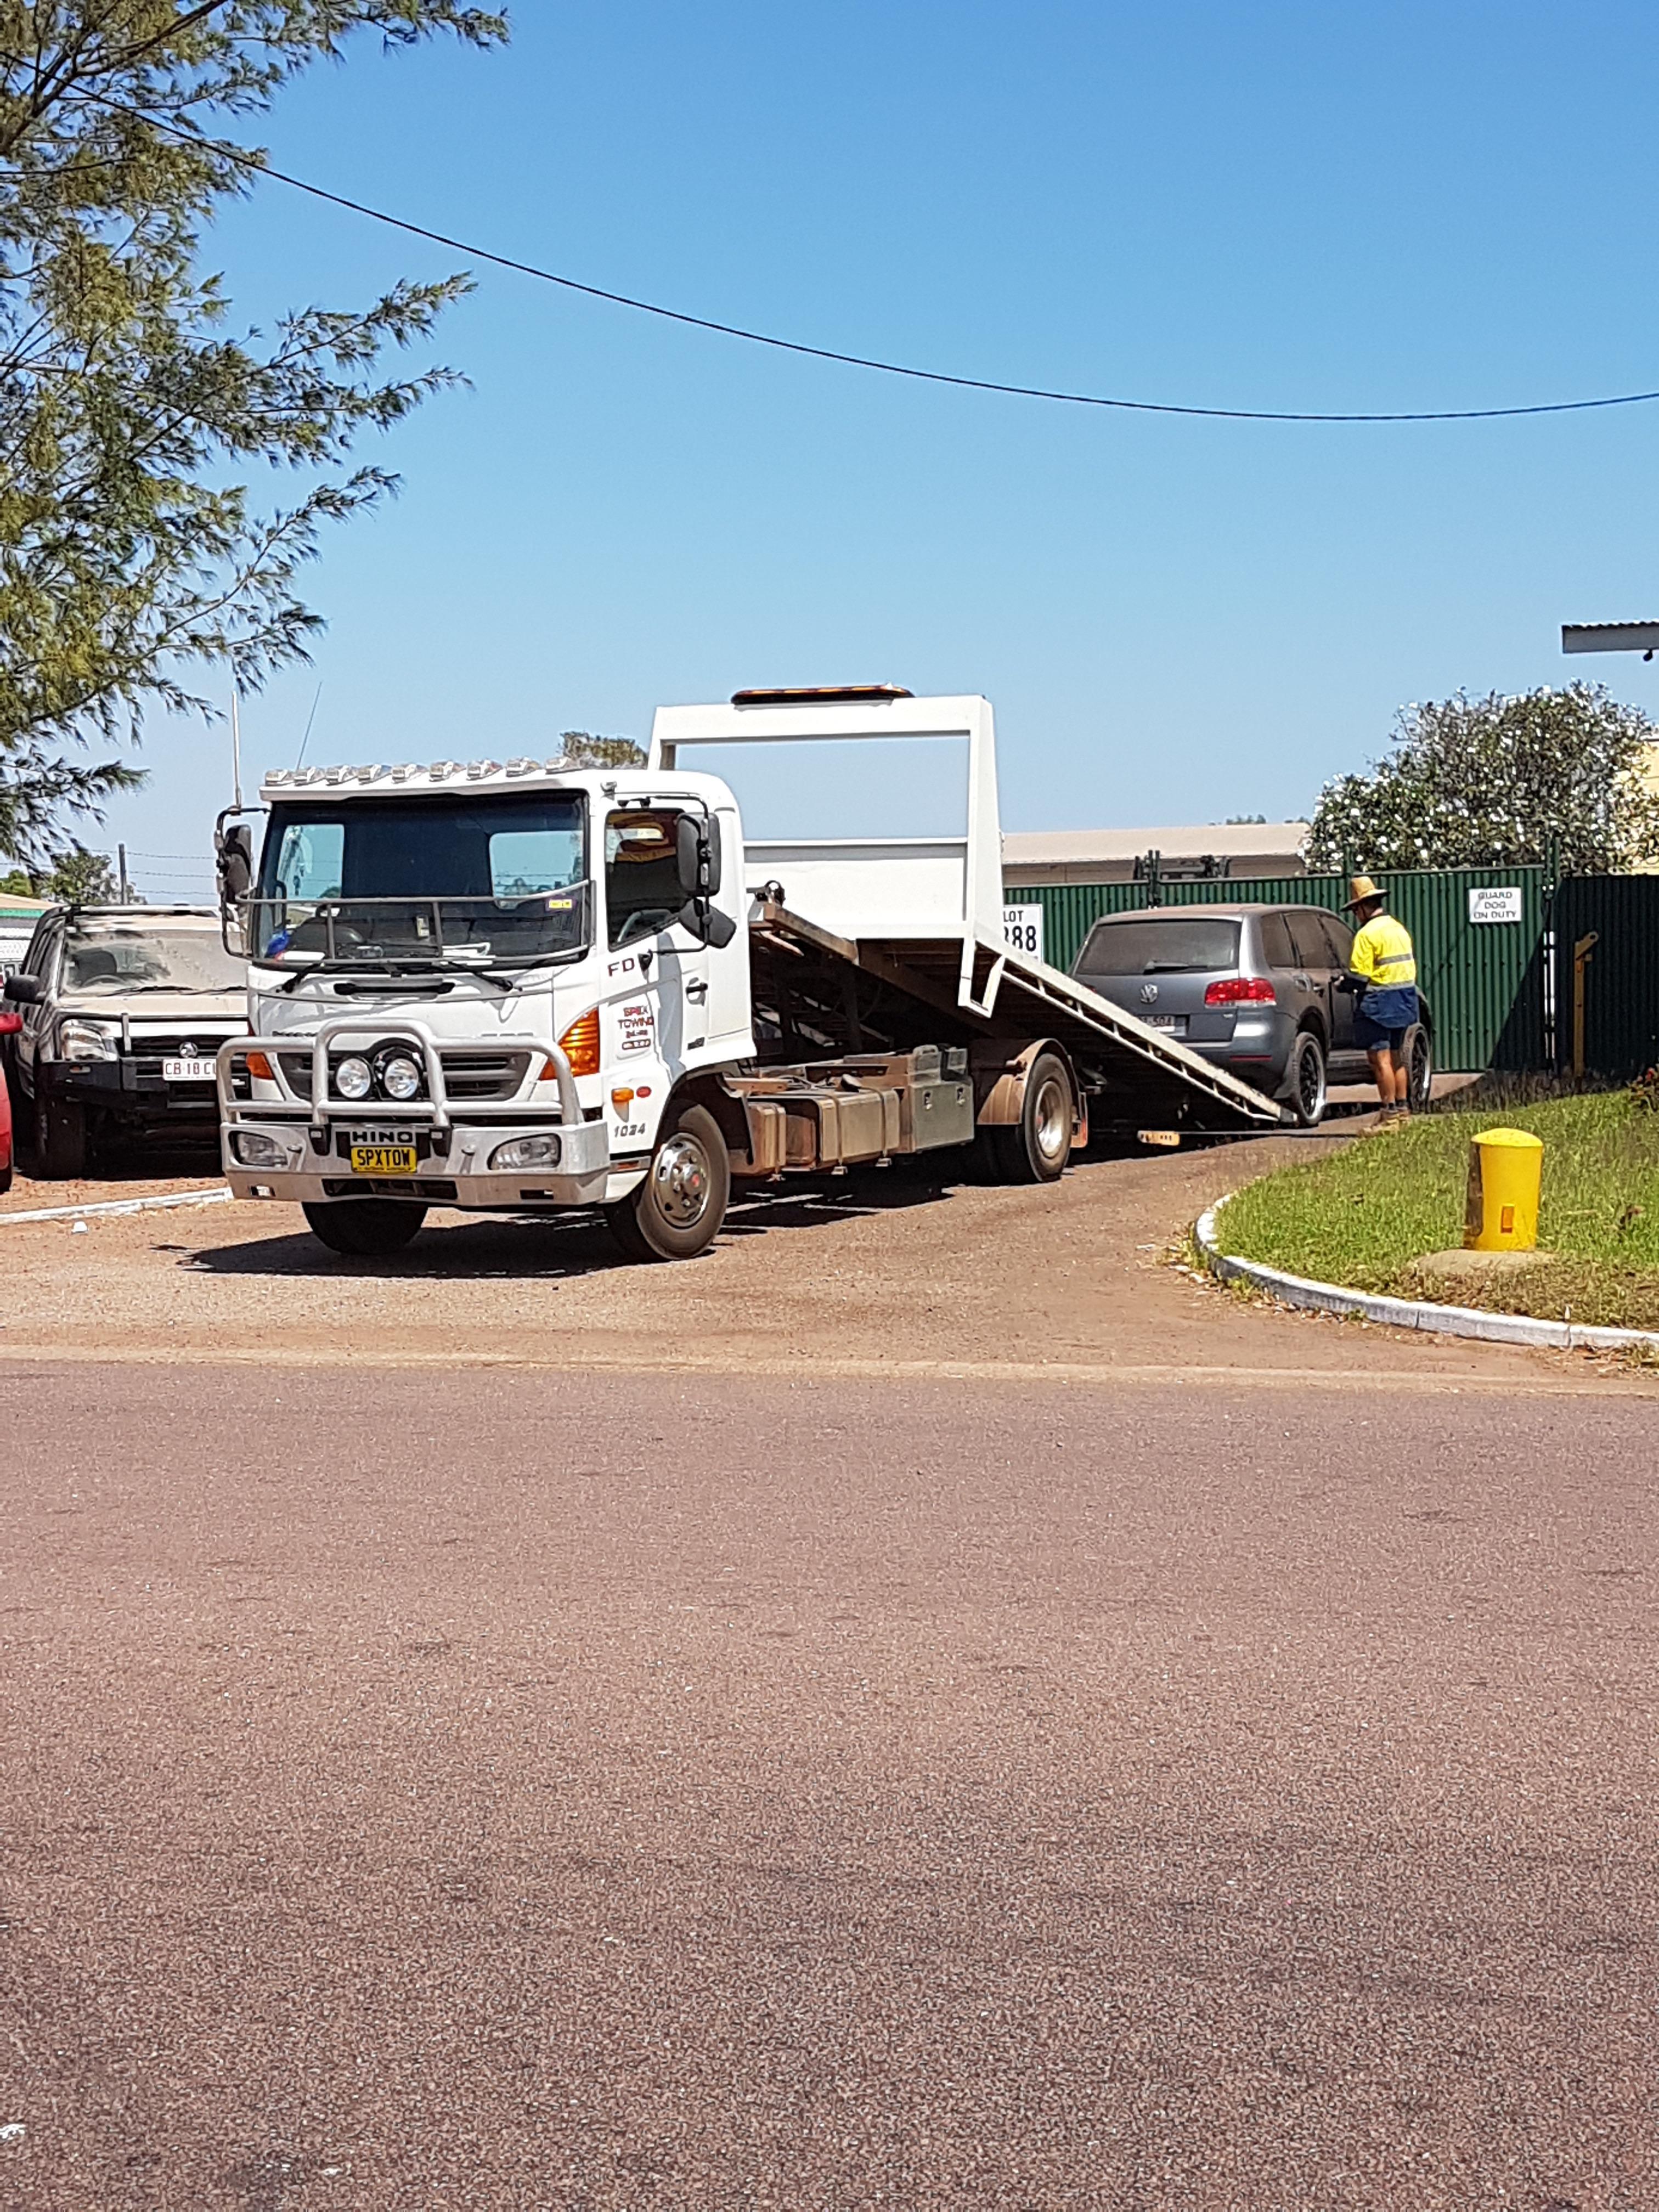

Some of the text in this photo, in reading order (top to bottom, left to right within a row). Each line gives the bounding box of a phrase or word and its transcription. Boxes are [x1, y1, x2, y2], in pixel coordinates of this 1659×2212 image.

[1477, 891, 1513, 900] GUARD
[1485, 901, 1506, 909] DOG
[1003, 910, 1024, 922] LOT
[607, 957, 635, 977] FD
[166, 1062, 181, 1075] CB
[352, 1131, 413, 1143] HINO
[357, 1149, 410, 1166] SPXTOW
